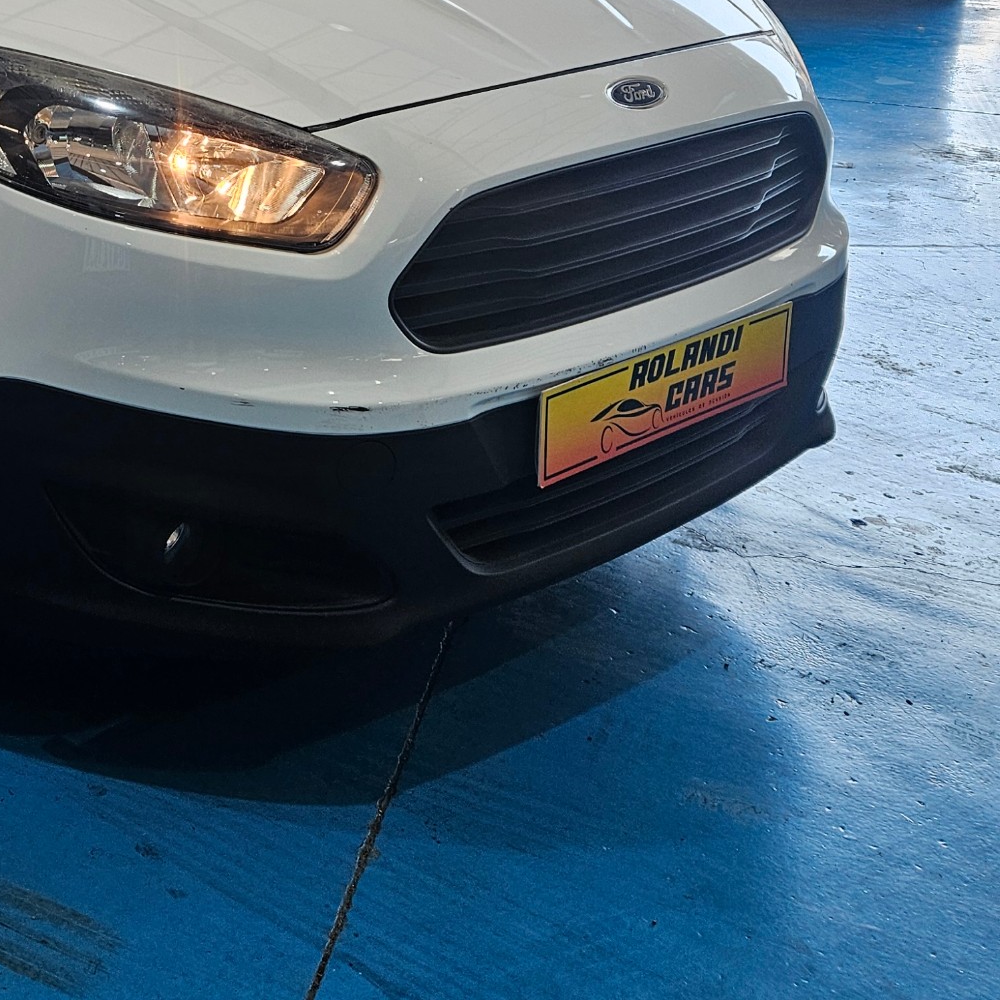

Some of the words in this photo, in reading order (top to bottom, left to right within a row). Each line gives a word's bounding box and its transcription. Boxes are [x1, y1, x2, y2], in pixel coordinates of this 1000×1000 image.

[621, 83, 656, 102] Ford
[629, 325, 744, 391] ROLANDI
[665, 361, 736, 412] CARS
